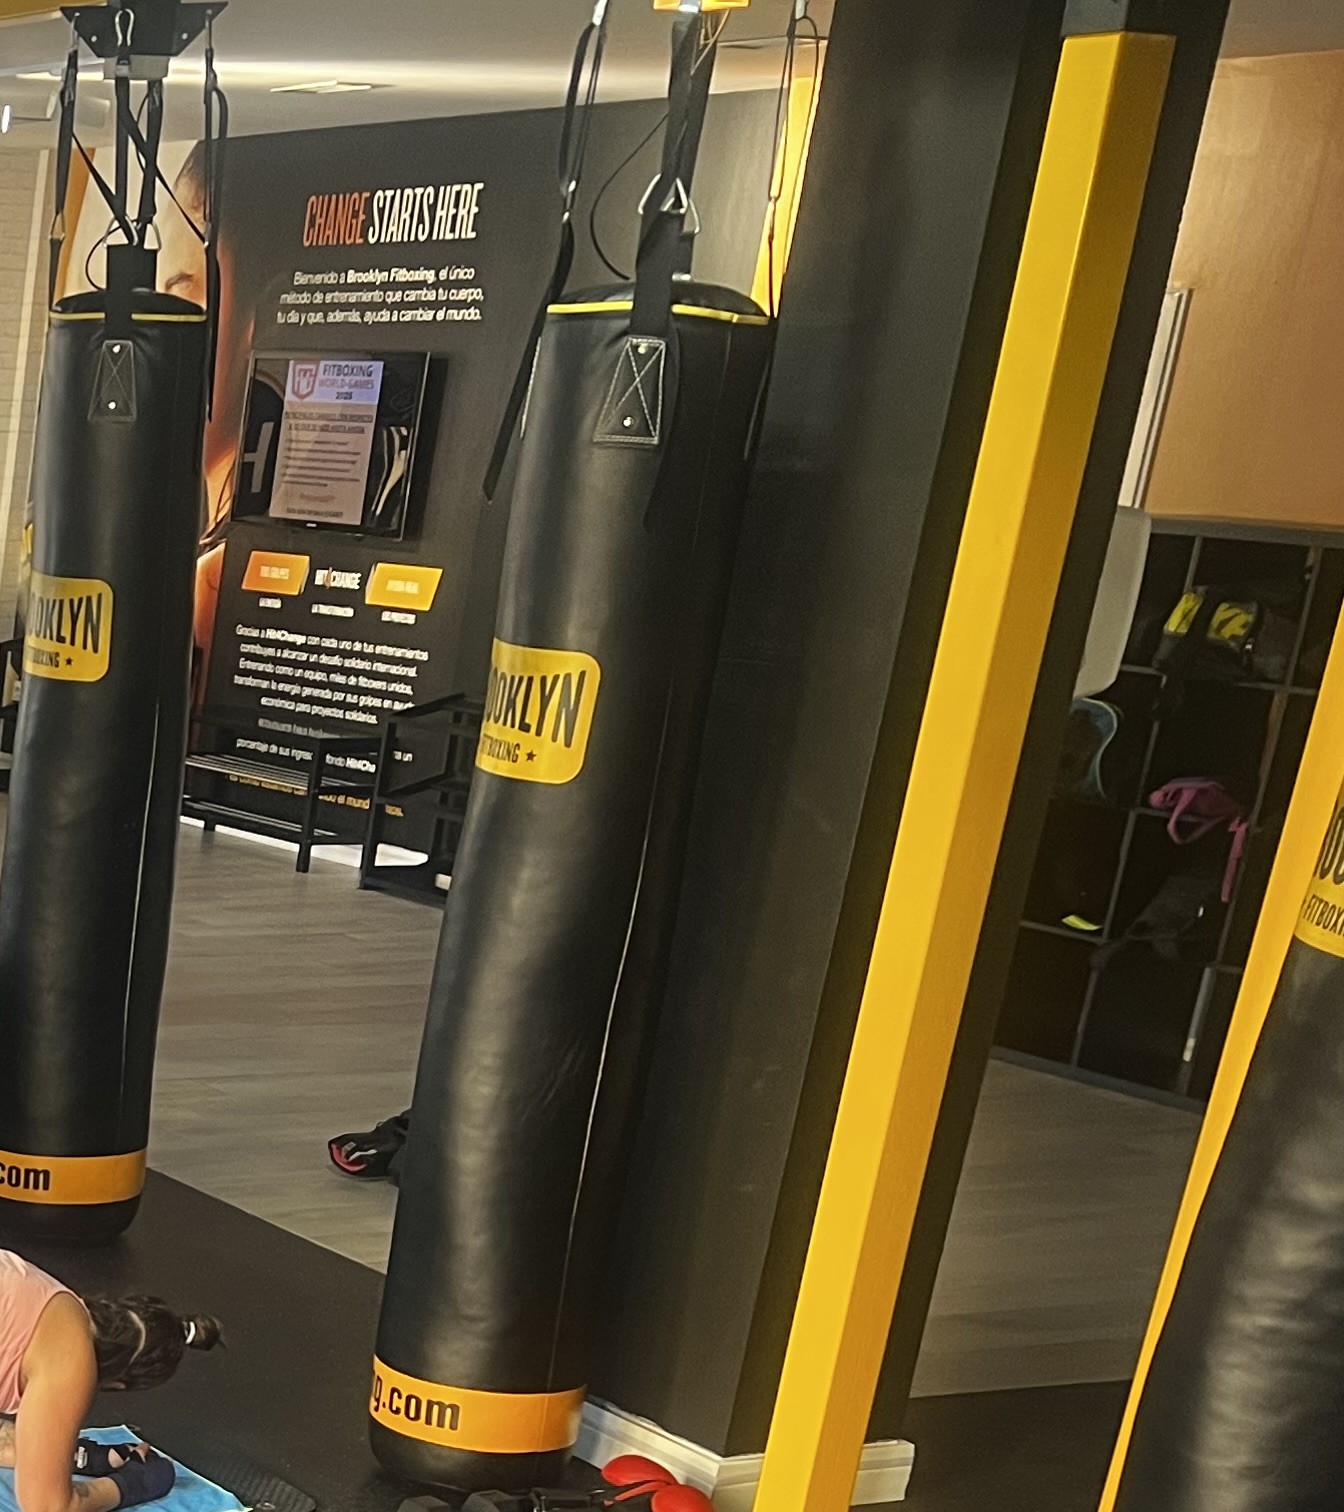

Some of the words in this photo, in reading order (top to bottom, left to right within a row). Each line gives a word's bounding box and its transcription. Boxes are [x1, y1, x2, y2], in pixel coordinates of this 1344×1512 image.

[303, 192, 370, 246] CHANGE
[368, 186, 435, 244] STARTS
[432, 182, 484, 240] HERE
[294, 271, 338, 285] Bienvenido
[339, 272, 346, 284] a
[347, 269, 388, 285] Brooklyn
[389, 267, 436, 284] Fitboxing,
[438, 265, 449, 280] el
[449, 265, 475, 280] único
[279, 290, 312, 304] método
[313, 290, 324, 304] de
[385, 290, 402, 304] que
[403, 287, 436, 302] cambia
[438, 287, 448, 301] tu
[449, 288, 484, 303] cuerpo,
[277, 311, 286, 323] tu
[299, 313, 306, 326] y
[363, 308, 390, 325] ayuda
[392, 310, 398, 322] a
[399, 306, 435, 322] cambiar
[436, 306, 446, 321] el
[446, 305, 481, 321] mundo.
[323, 364, 373, 378] FITBOXING
